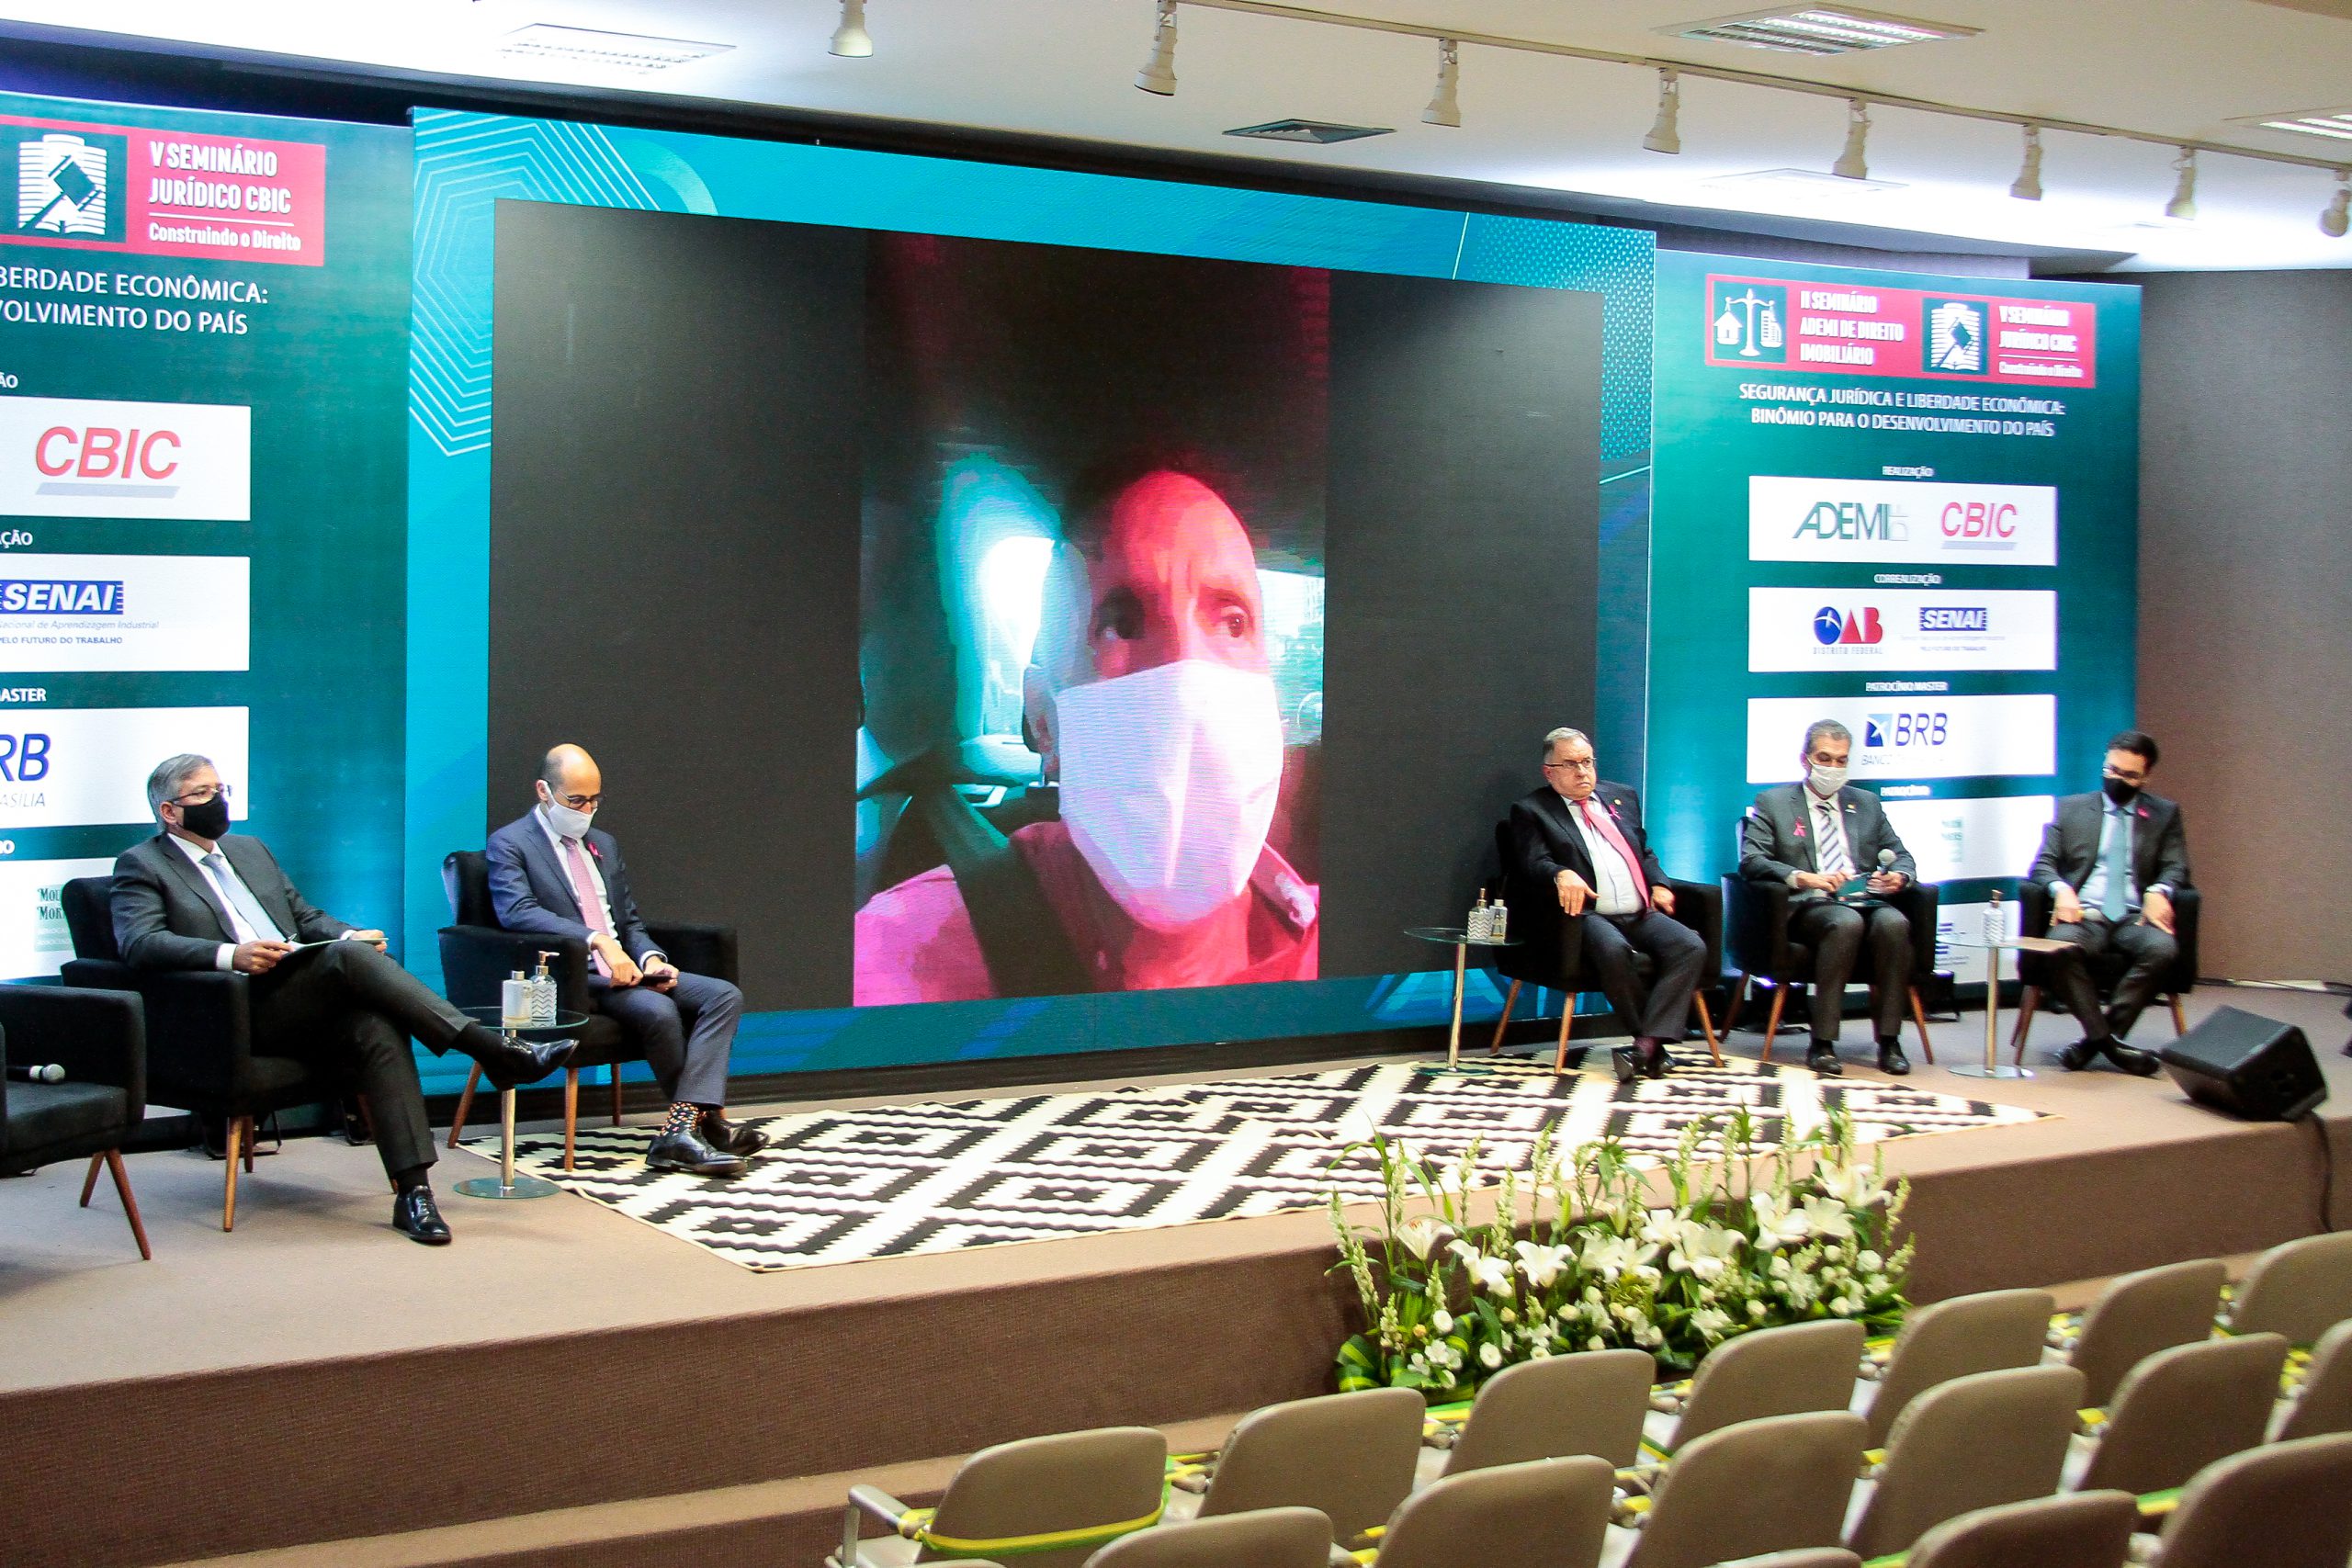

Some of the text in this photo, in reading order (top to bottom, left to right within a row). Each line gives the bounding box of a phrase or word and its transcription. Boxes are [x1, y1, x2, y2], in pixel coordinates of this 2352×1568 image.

[149, 141, 277, 177] V SEMINÁRIO
[149, 175, 292, 214] JURÍDICO CBIC
[149, 222, 302, 251] Construindo o Direito
[116, 274, 268, 304] ECONÔMICA:
[1811, 290, 1878, 313] SEMINÁRIO
[0, 299, 248, 335] OLVIMENTO DO PAÍS
[1800, 317, 1904, 342] ADEMI DE DIREITO
[1800, 343, 1874, 366] IMOBILIÁRIO
[1739, 383, 1826, 406] SEGURANÇA
[1828, 387, 1894, 407] JURÍDICA
[1895, 392, 1905, 408] E
[1906, 393, 1980, 412] LIBERDADE
[1751, 406, 2055, 437] BINÔMIO PARA O DESENVOLVIMENTO DO PAÍS
[36, 426, 182, 479] CBIC
[1792, 502, 1890, 540] ADEMI
[1940, 502, 2018, 537] CBIC
[0, 529, 33, 549] ÇÃO
[3, 582, 116, 611] SENAI
[0, 621, 35, 629] acional
[1814, 606, 1883, 645] OAB
[1922, 609, 1984, 629] SENAI
[0, 687, 47, 702] ASTER
[1895, 713, 1948, 746] BRB
